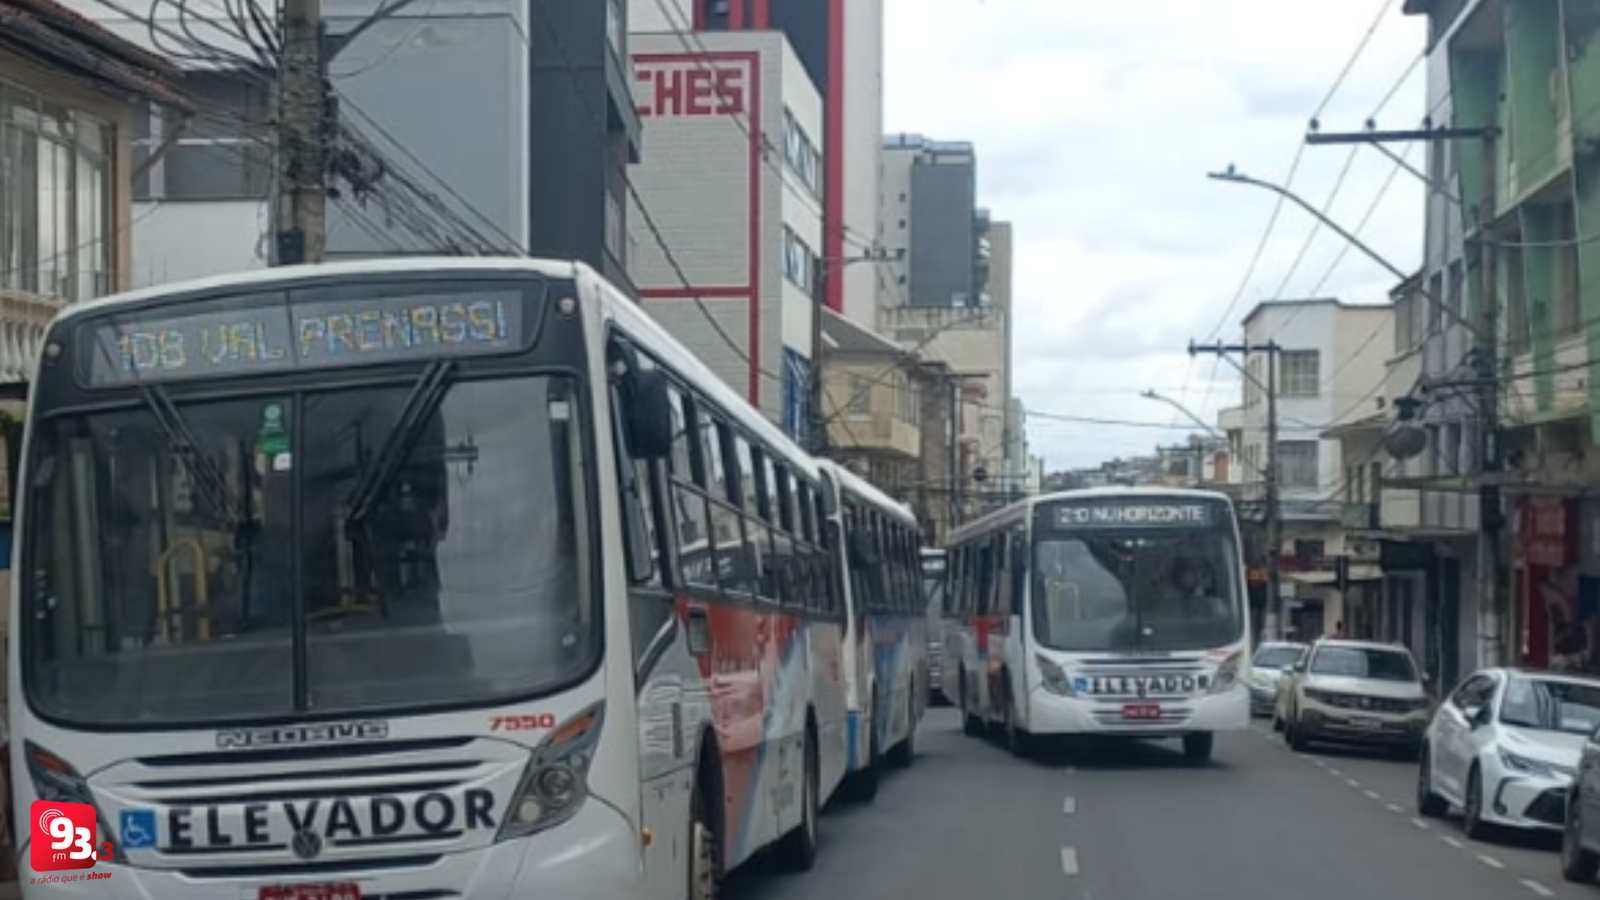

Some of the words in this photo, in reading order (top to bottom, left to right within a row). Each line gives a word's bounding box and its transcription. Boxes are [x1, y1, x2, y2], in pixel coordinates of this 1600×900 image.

[301, 301, 507, 355] PRENASSI
[488, 713, 556, 732] 7550
[168, 789, 498, 847] ELEVADOR
